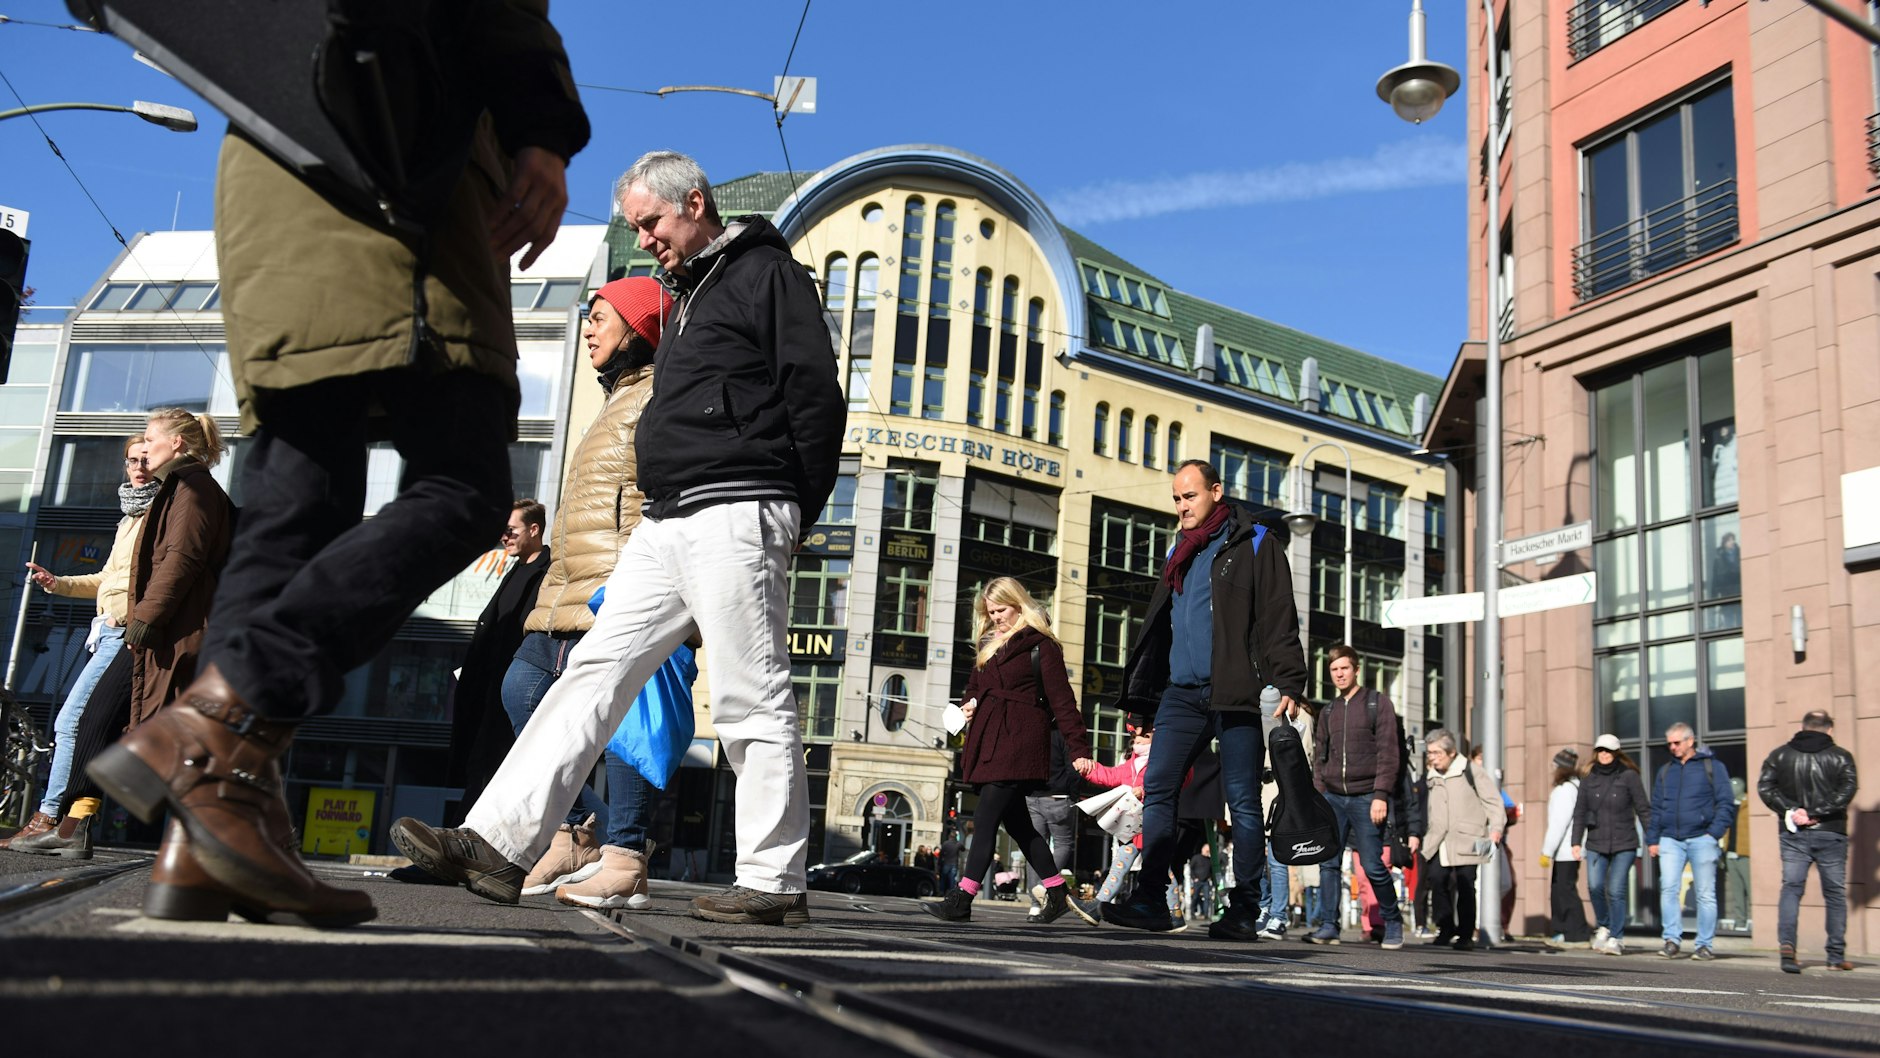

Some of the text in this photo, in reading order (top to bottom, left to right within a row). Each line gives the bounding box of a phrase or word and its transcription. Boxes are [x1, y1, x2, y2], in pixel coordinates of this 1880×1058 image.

[845, 427, 1060, 478] CKESCHEN HÖFE
[887, 545, 928, 559] BERLIN
[1510, 531, 1583, 556] Hackescher Markt
[323, 799, 358, 811] PLAY IT
[315, 810, 362, 823] FORWARD
[1291, 840, 1325, 860] Fame
